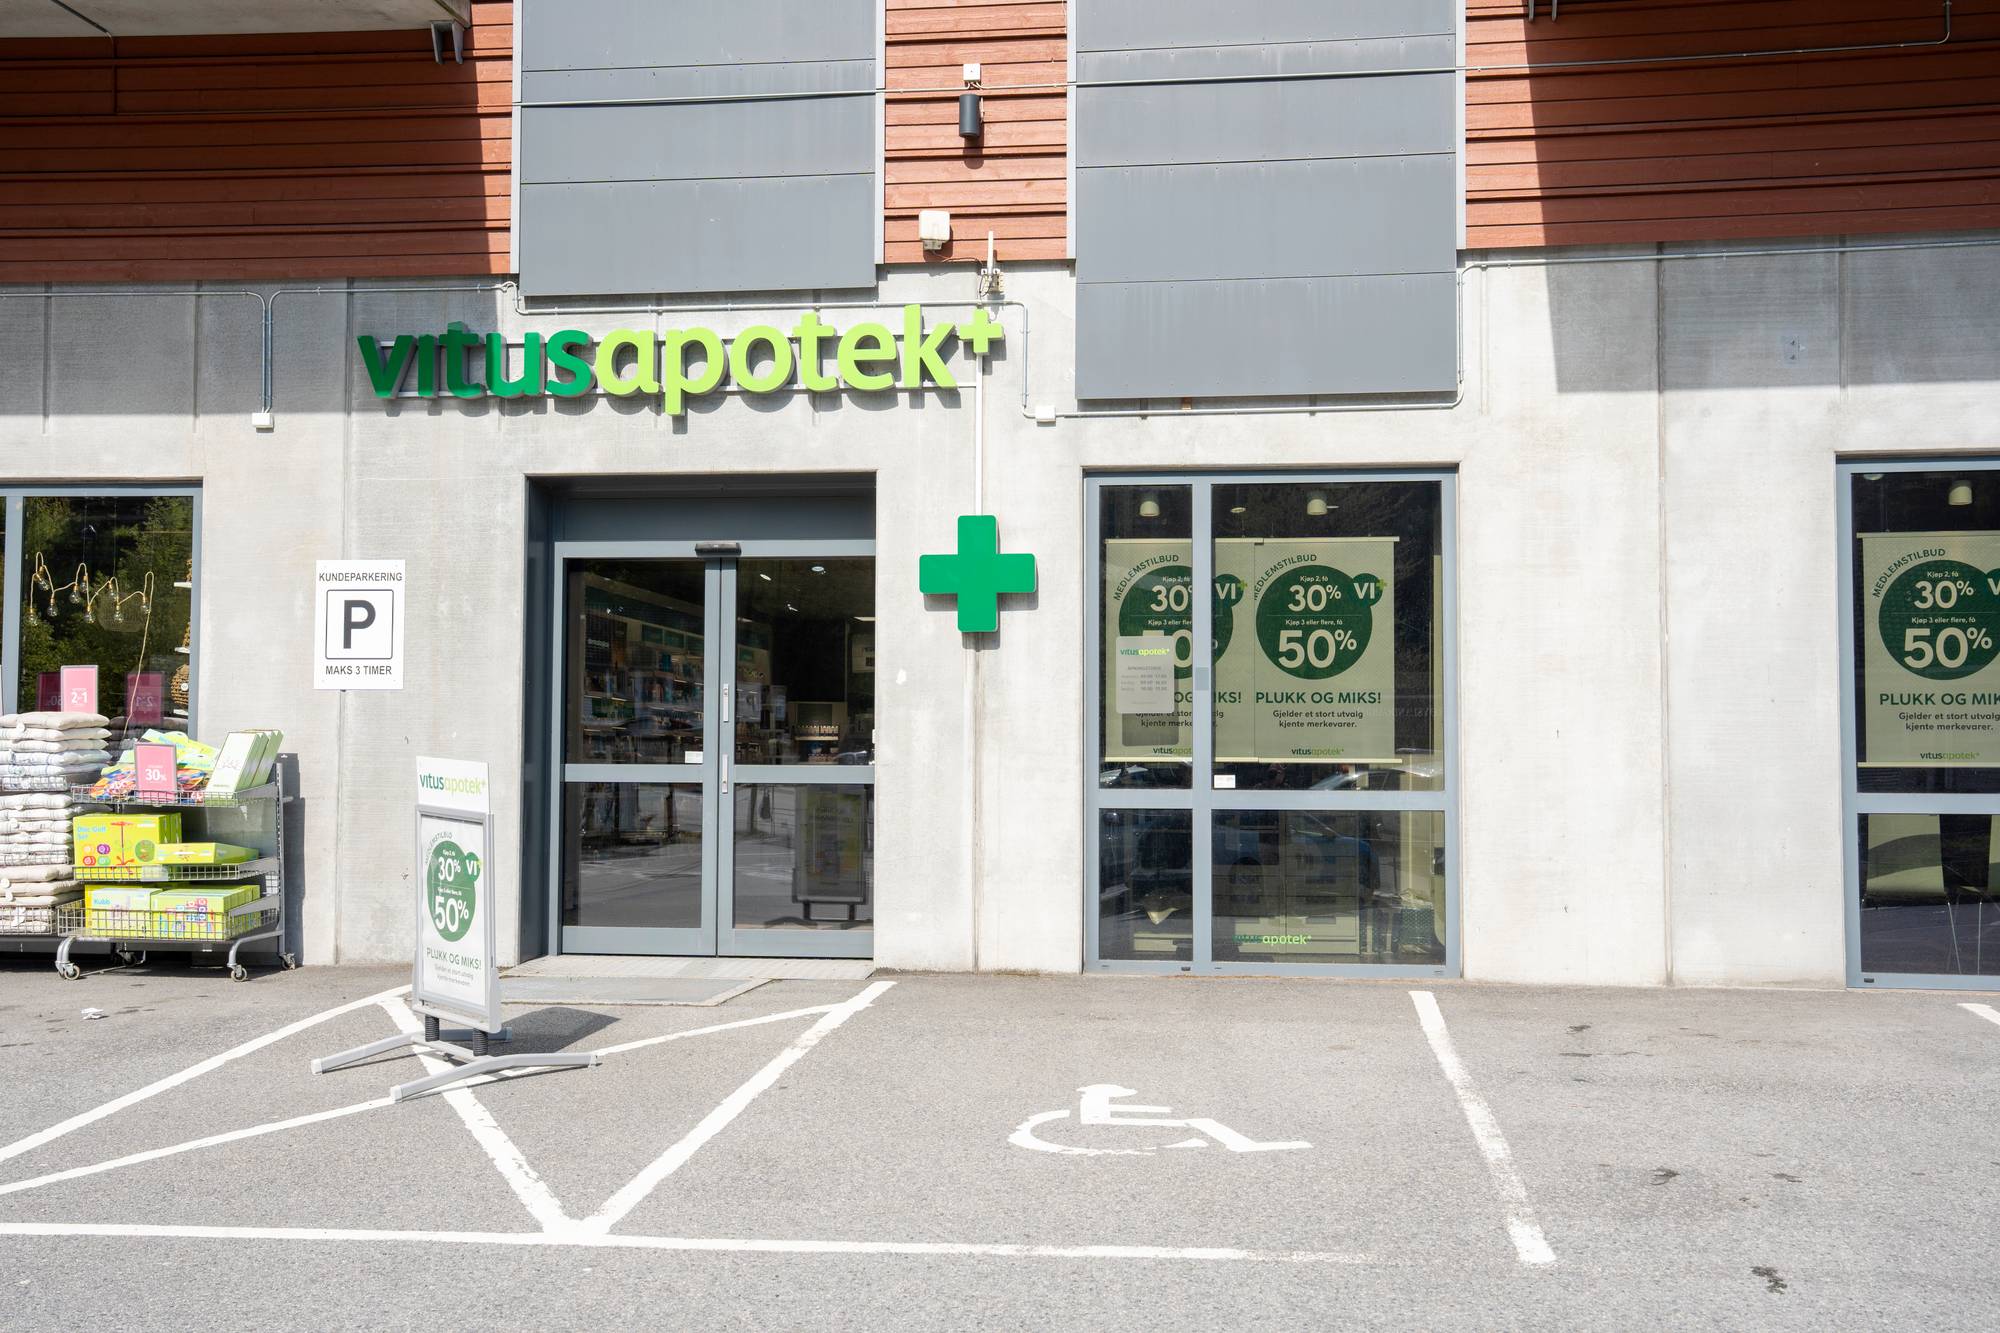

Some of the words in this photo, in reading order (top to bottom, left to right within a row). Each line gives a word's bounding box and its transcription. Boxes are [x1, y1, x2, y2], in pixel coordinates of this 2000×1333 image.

[319, 572, 403, 581] KUNDEPARKERING
[1113, 555, 1179, 601] MEDLEMSTILBUD
[1872, 548, 1946, 598] MEDLEMSTILBUD
[1914, 580, 1974, 609] 30%
[1988, 578, 2000, 595] V
[1288, 585, 1341, 612] 30%
[343, 600, 376, 649] P
[1278, 629, 1357, 669] 50%
[1904, 627, 1993, 669] 50%
[326, 666, 353, 675] MAKS
[355, 666, 361, 675] 3
[363, 666, 392, 675] TIMER
[1256, 692, 1306, 704] PLUKK
[1311, 692, 1334, 704] OG
[1338, 692, 1381, 704] MIKS!
[1880, 693, 1936, 705] PLUKK
[1941, 693, 1967, 705] OG
[1972, 693, 2000, 705] MIK
[1273, 710, 1302, 719] Gjelder
[1337, 710, 1363, 719] utvalg
[1280, 720, 1304, 728] kjente
[1307, 720, 1357, 728] merkevarer.
[1899, 712, 1932, 721] Gjelder
[1906, 723, 1934, 731] kjente
[145, 768, 167, 782] 30%
[438, 857, 461, 880] 30%
[435, 895, 469, 933] 50%
[426, 947, 447, 962] PLUKK
[449, 953, 460, 965] OG
[461, 956, 482, 970] MIKS!
